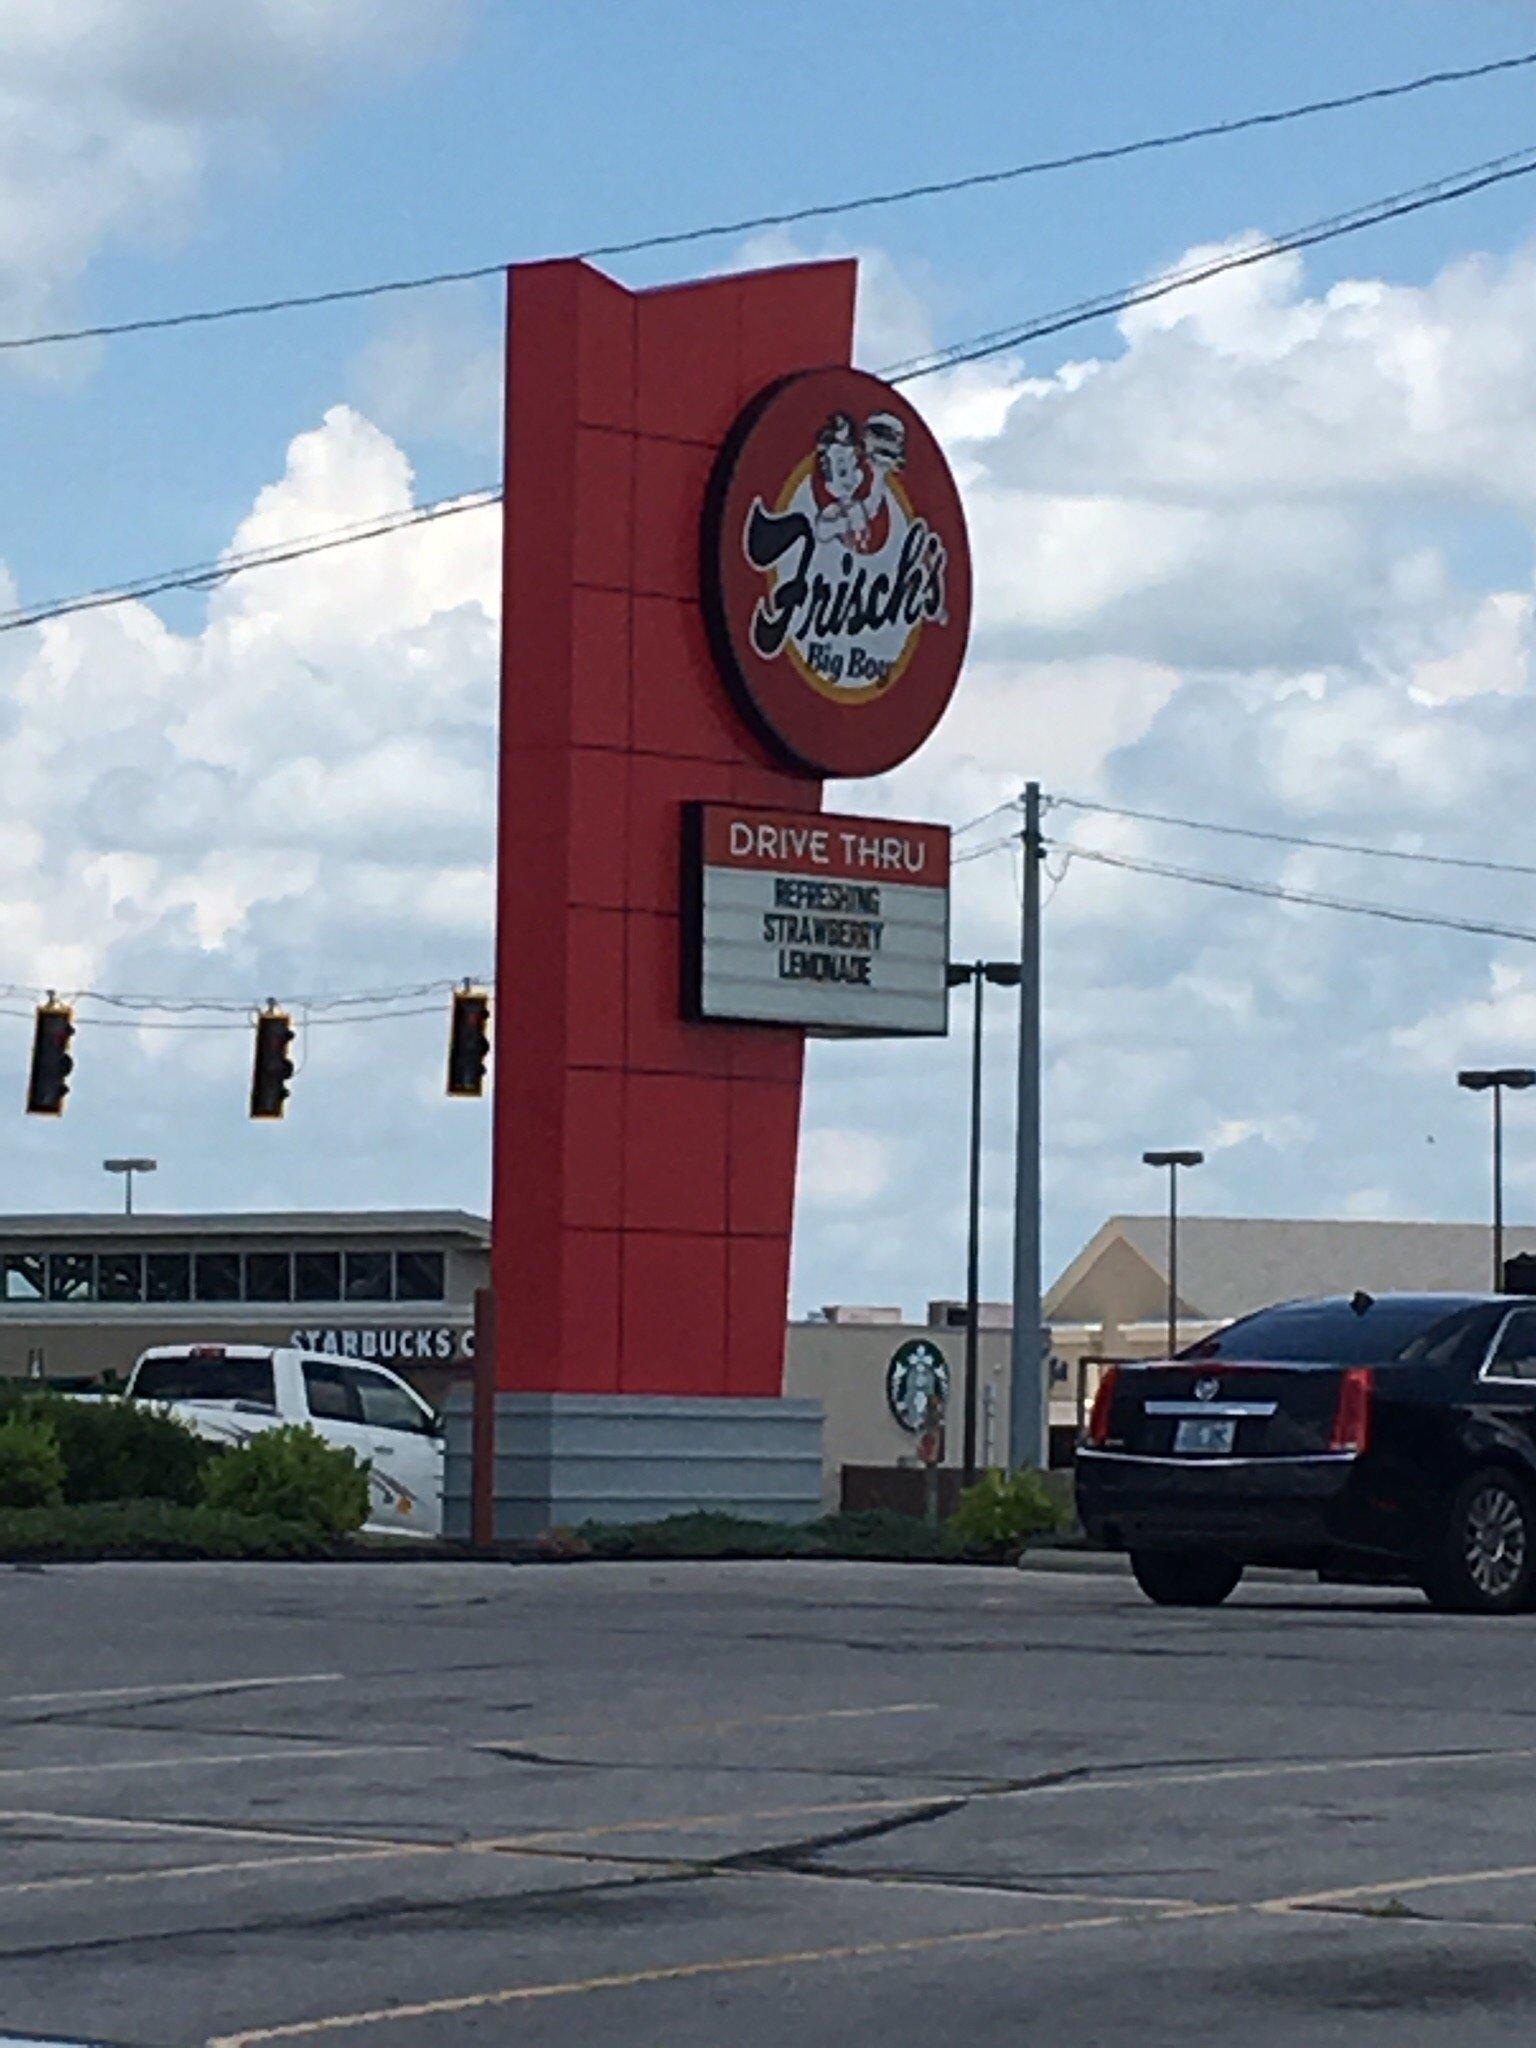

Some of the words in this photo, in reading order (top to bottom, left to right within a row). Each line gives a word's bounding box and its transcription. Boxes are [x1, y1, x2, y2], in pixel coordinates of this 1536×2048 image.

[746, 498, 945, 657] Frisch's
[807, 641, 844, 682] Big
[846, 646, 889, 687] Boy
[729, 821, 829, 864] DRIVE
[839, 831, 926, 873] THRU
[763, 913, 885, 950] STRAWBERRY
[291, 1328, 451, 1357] STARBUCKS
